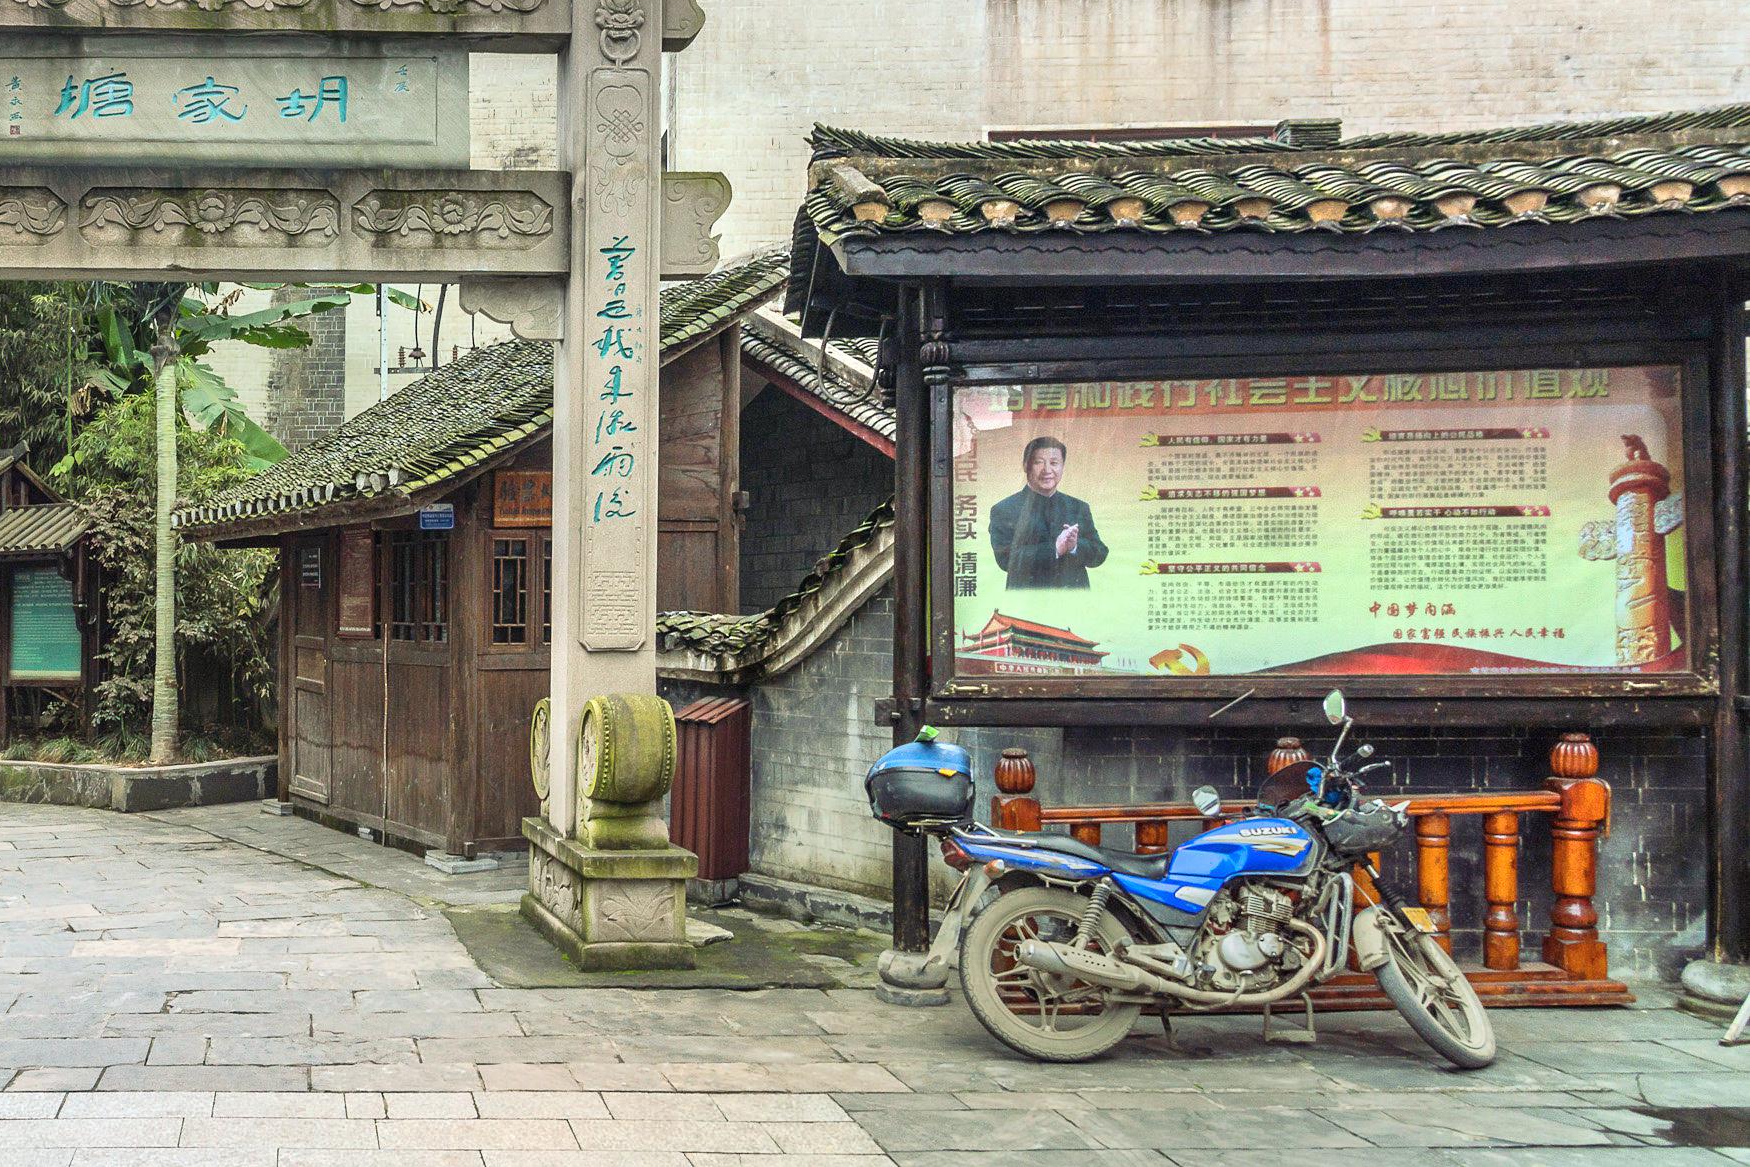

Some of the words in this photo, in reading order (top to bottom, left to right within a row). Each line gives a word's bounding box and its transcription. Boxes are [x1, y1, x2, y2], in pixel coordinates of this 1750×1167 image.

[54, 70, 348, 124] 胡家塘
[954, 494, 978, 540] 务实
[954, 551, 978, 598] 清廉
[1368, 601, 1457, 619] 中国梦内涵
[1392, 627, 1446, 640] 国家富强
[1450, 627, 1505, 640] 民族振兴
[1509, 626, 1566, 640] 人民幸福
[1239, 826, 1298, 838] SUZUKI
